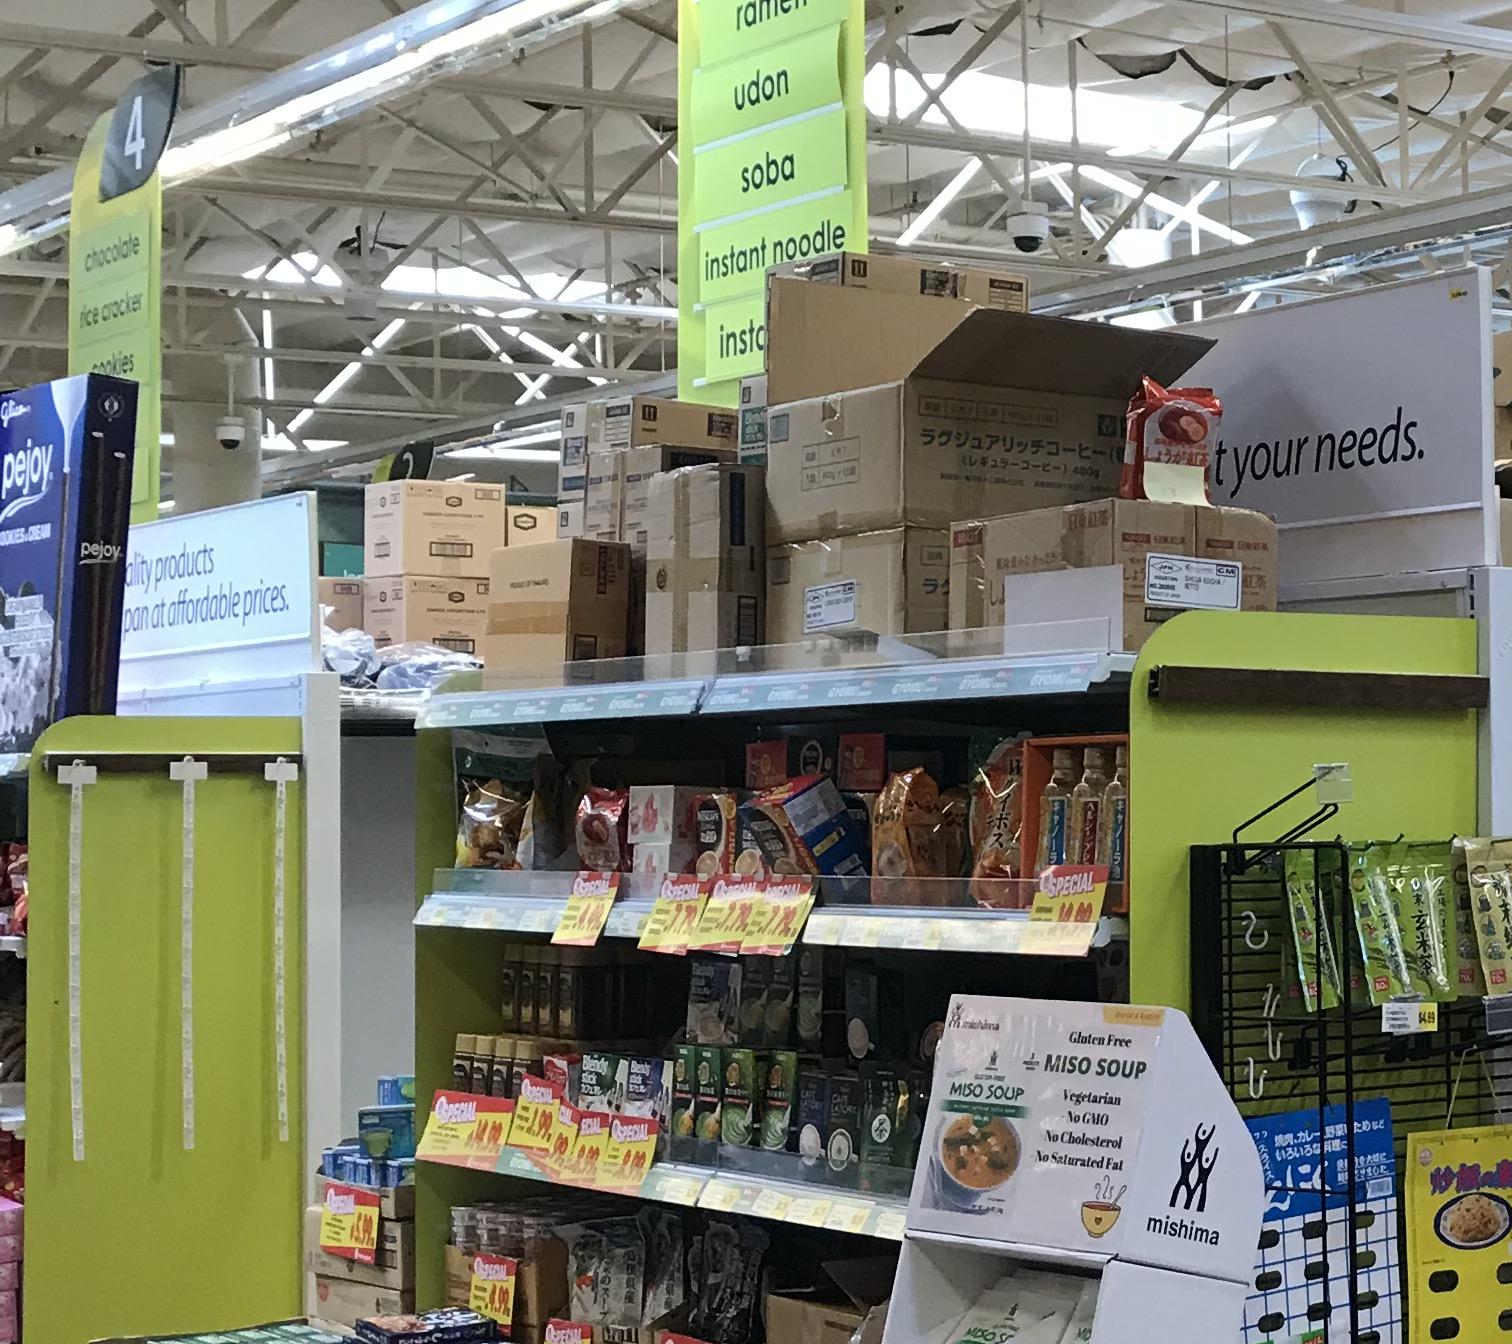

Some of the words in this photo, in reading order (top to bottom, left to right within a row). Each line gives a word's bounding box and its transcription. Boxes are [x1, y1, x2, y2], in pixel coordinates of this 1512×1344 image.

[733, 67, 789, 111] udon
[124, 94, 145, 170] 4
[741, 150, 795, 193] soba
[84, 233, 140, 273] chocolate
[704, 239, 767, 279] instant
[772, 219, 846, 261] noodle
[79, 305, 99, 329] rice
[102, 292, 143, 320] cracker
[1, 438, 54, 499] pejoy
[1230, 437, 1304, 499] your
[1313, 406, 1425, 474] needs.
[80, 540, 121, 559] pejoy
[155, 542, 214, 592] products
[152, 598, 166, 629] at
[168, 582, 240, 627] affordable
[243, 579, 289, 626] prices.
[1050, 872, 1094, 898] SPECIAL
[1069, 1031, 1105, 1047] Gluten
[1107, 1034, 1132, 1048] Free
[1044, 1054, 1092, 1075] MISO
[1095, 1057, 1147, 1080] SOUP
[950, 1081, 985, 1098] MISO
[987, 1084, 1024, 1102] SOUP
[1062, 1088, 1121, 1107] Vegetarian
[1083, 1111, 1109, 1127] GMO
[1060, 1132, 1123, 1150] Cholesterol
[1049, 1153, 1102, 1170] Saturated
[1105, 1157, 1124, 1173] Fat
[1147, 1215, 1221, 1246] mishima
